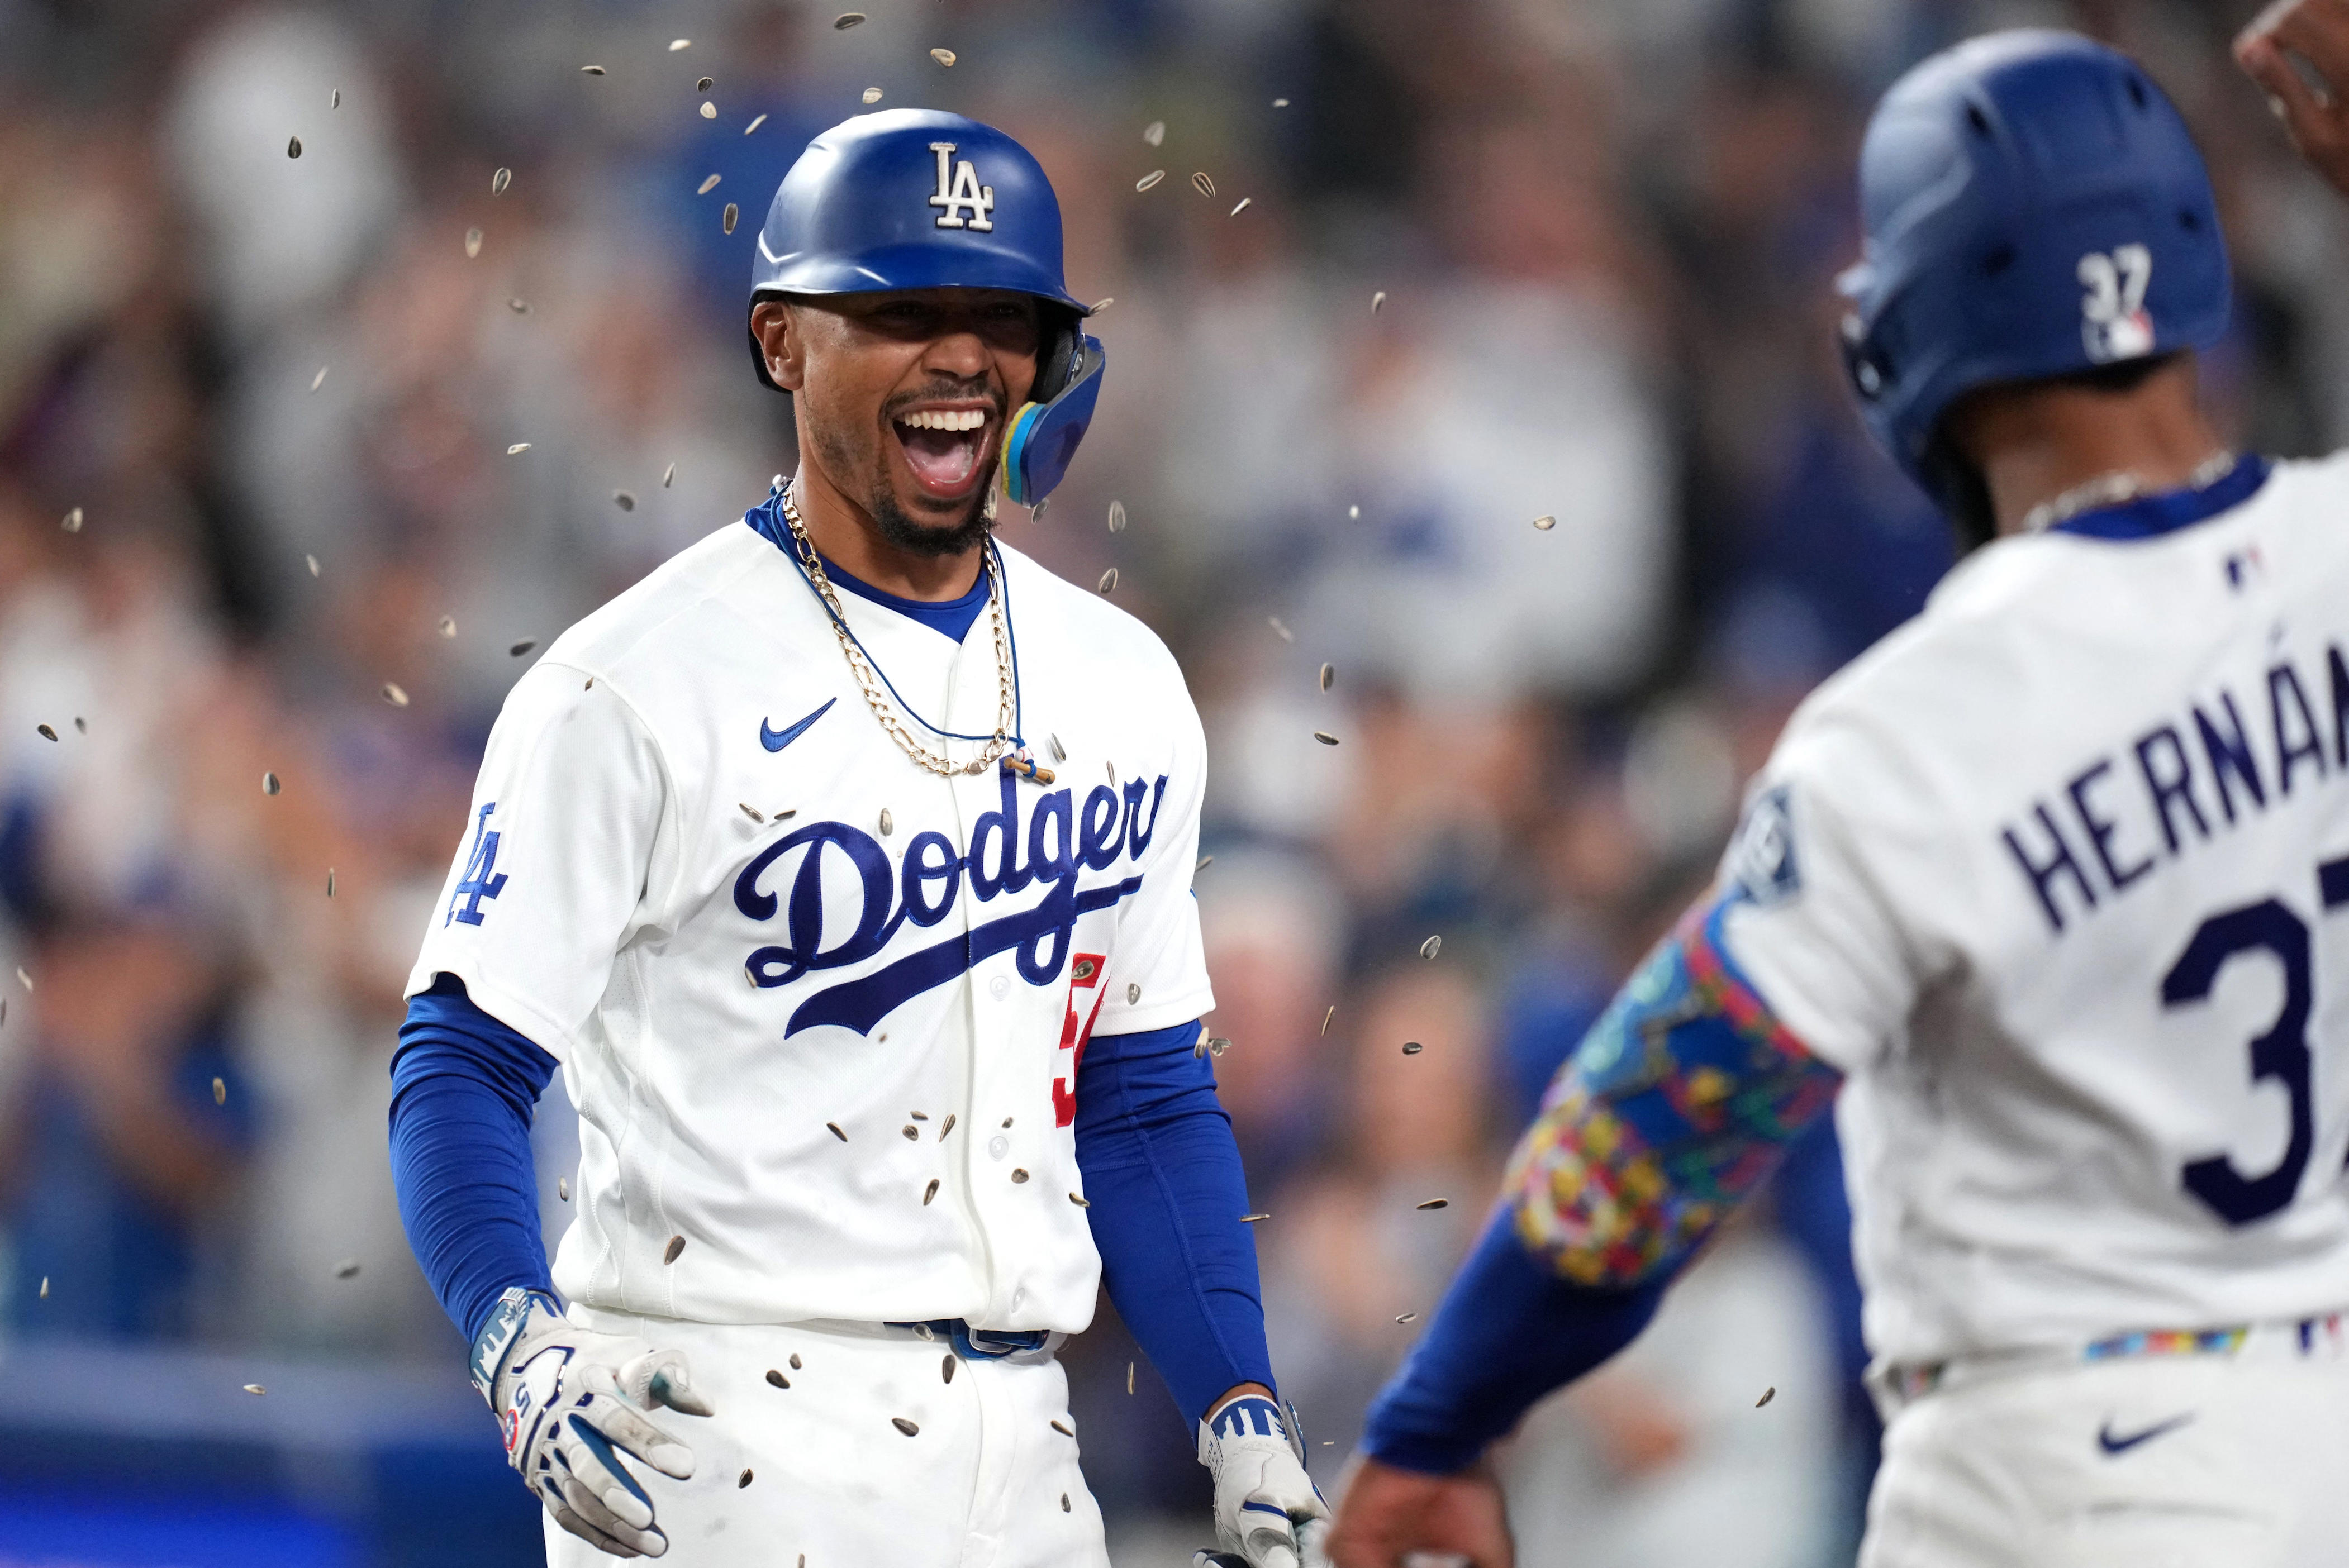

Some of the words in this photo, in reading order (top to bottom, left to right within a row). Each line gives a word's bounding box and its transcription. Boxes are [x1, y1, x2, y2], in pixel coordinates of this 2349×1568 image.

[929, 142, 994, 231] LA
[2076, 241, 2152, 323] 37
[444, 802, 508, 929] LA
[1052, 952, 1111, 1128] 5
[2160, 855, 2349, 1228] 3
